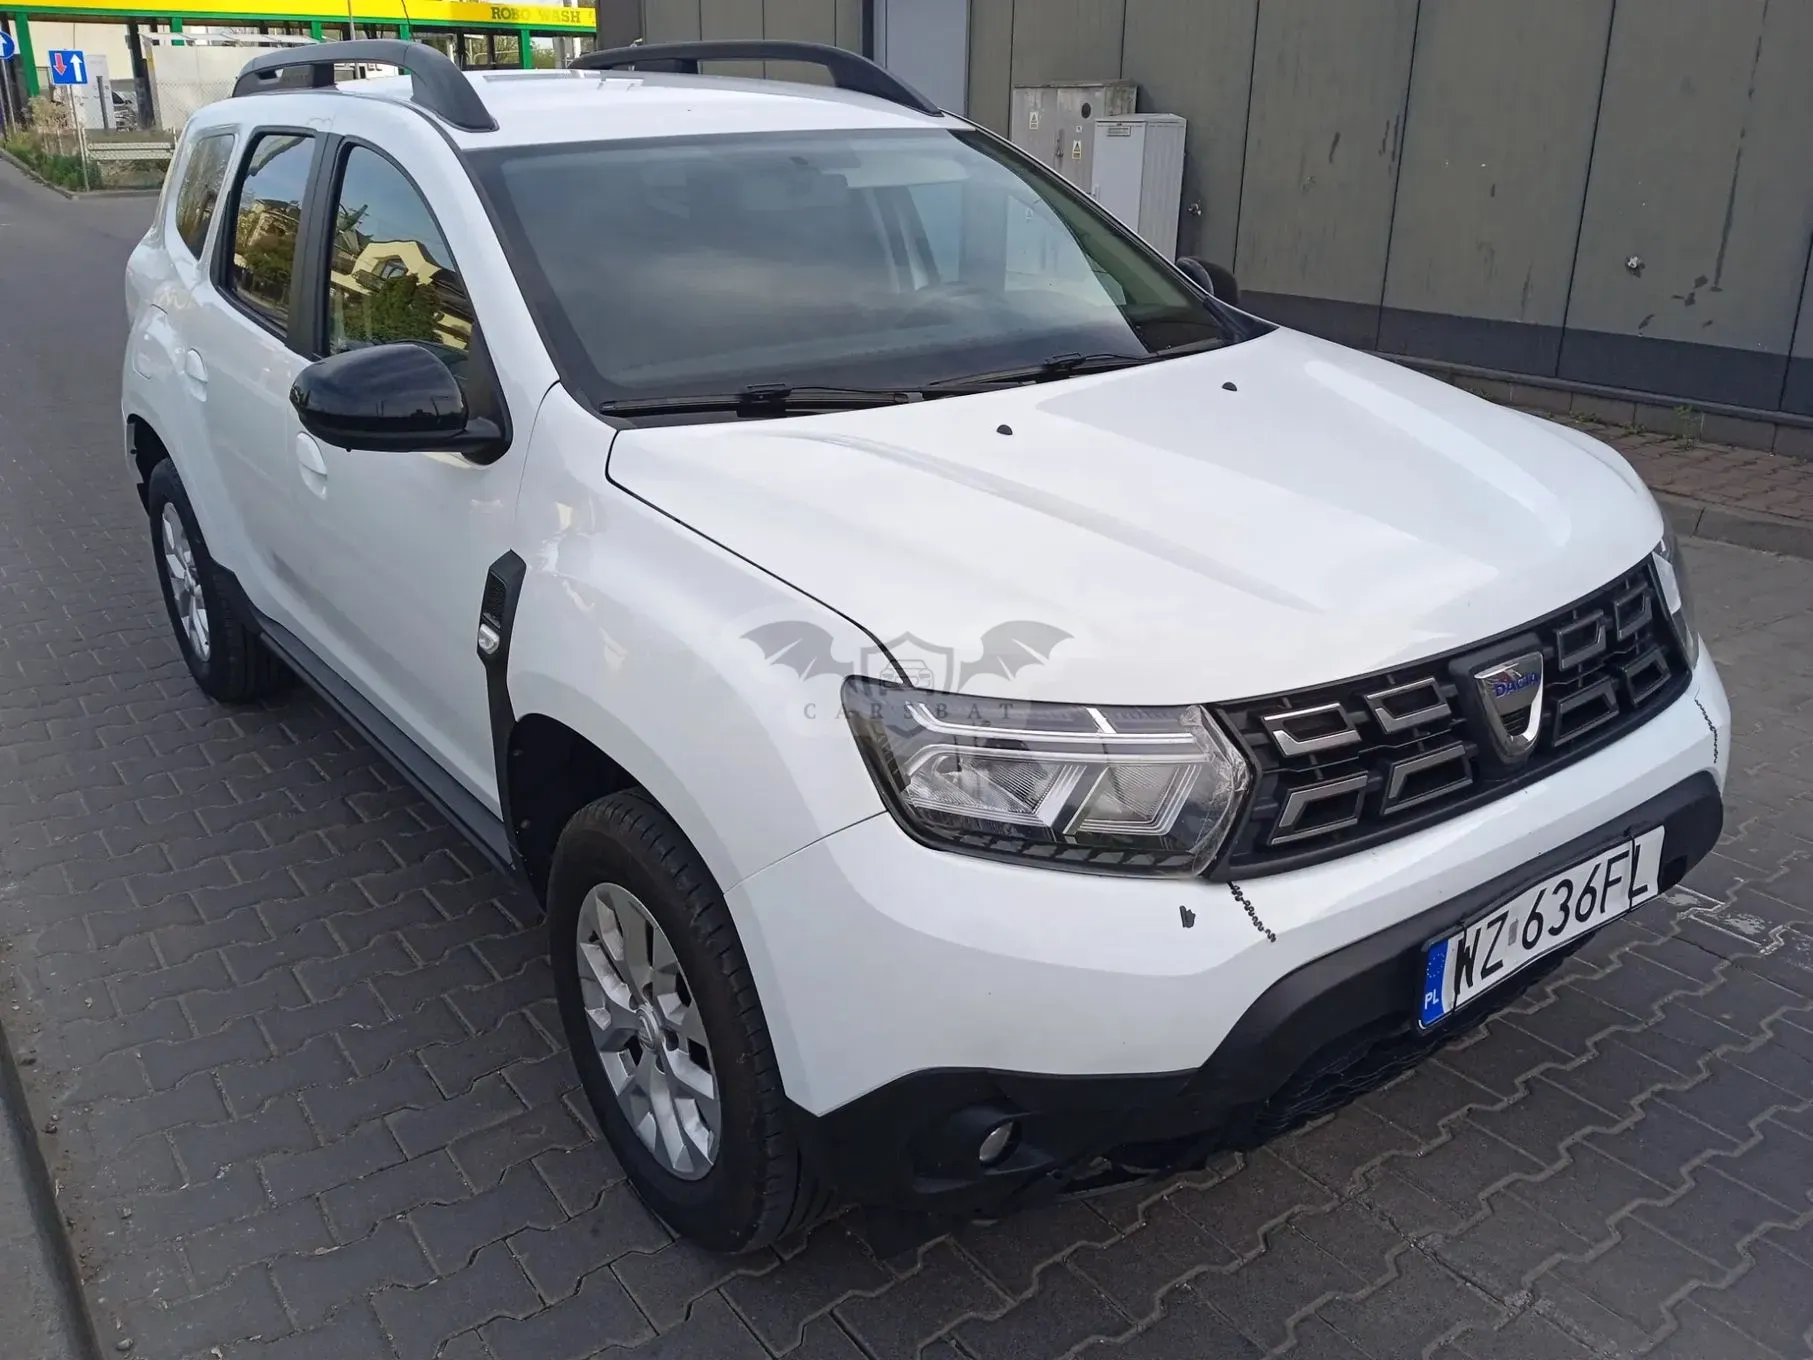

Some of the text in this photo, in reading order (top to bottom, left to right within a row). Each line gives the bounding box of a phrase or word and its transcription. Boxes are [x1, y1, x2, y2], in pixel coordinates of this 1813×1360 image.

[491, 7, 530, 20] ROBO
[538, 9, 581, 23] WASH
[1495, 673, 1540, 697] DACIA
[1424, 989, 1440, 1010] PL
